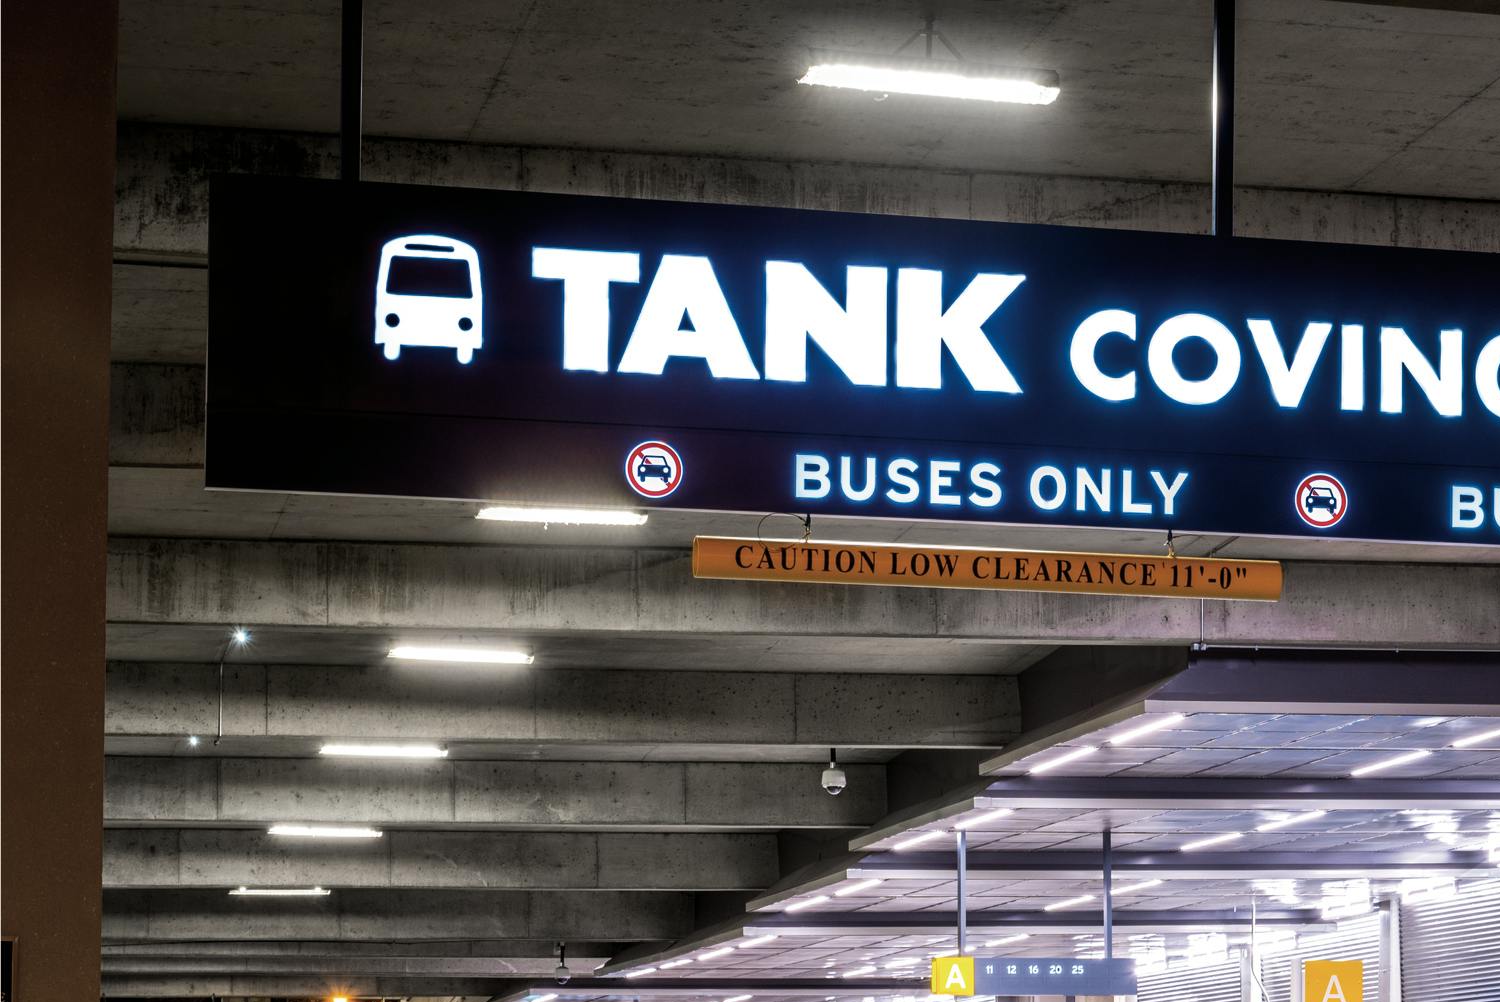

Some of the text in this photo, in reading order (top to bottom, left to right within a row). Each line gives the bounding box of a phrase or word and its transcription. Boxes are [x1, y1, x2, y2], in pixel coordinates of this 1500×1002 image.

[531, 246, 1026, 395] TANK
[795, 454, 1189, 515] BUSES ONLY
[735, 544, 877, 574] CAUTION
[890, 552, 959, 577] LOW
[973, 556, 1157, 586] CLEARANCE
[945, 963, 1084, 989] A 11 12 16 20 25
